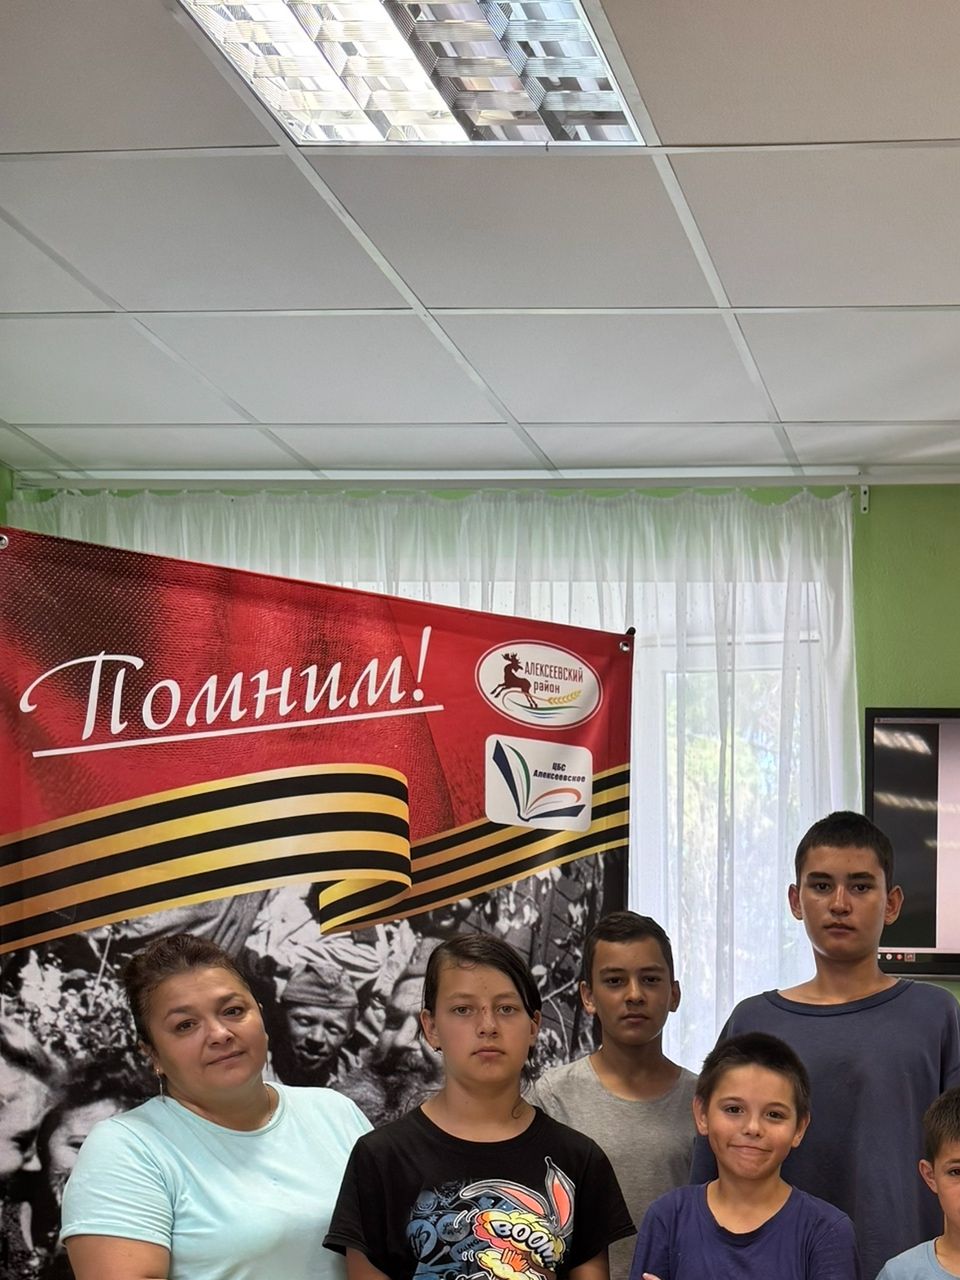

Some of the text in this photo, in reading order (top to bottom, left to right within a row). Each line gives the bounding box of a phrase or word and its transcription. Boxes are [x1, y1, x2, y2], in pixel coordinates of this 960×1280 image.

[524, 661, 584, 684] АЛЕКСЕЕВСКИЙ
[19, 626, 432, 740] Помним!
[533, 679, 560, 694] район
[551, 761, 567, 772] ЦБС
